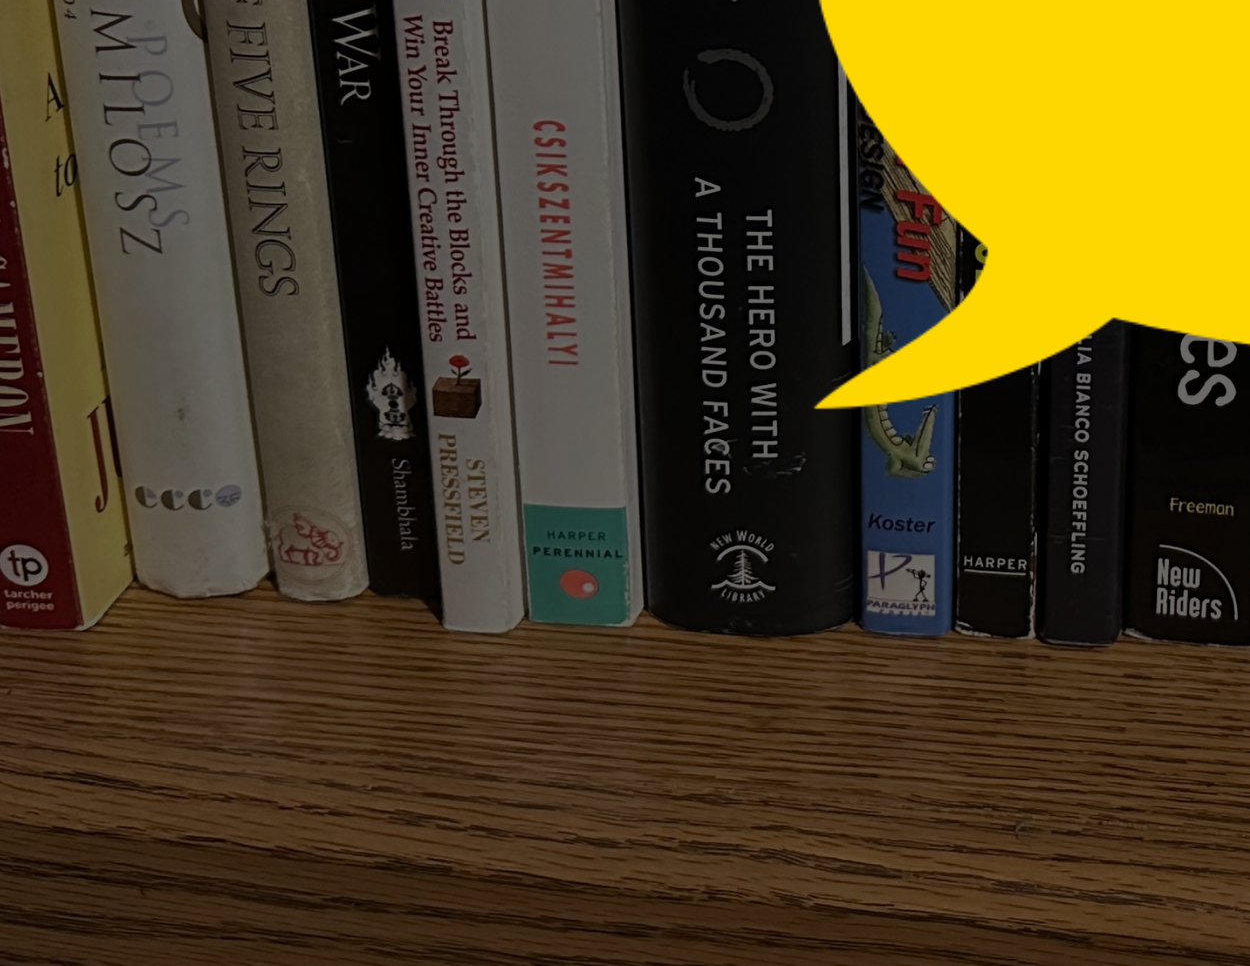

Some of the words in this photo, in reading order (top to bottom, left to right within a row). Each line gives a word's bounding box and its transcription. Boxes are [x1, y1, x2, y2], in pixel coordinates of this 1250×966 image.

[330, 2, 382, 107] WAR
[403, 14, 424, 62] Win
[432, 19, 453, 84] Break
[226, 21, 283, 132] FIVE
[405, 65, 428, 117] Your
[126, 32, 190, 231] POEMS
[410, 121, 432, 183] Inner
[436, 90, 466, 184] Through
[242, 146, 300, 299] RINGS
[416, 187, 438, 276] Creative
[444, 188, 465, 225] the
[895, 189, 943, 283] Fun
[447, 229, 470, 296] Blocks
[533, 119, 580, 367] CSIKSZENTMIHALYI
[744, 208, 775, 274] THE
[422, 277, 447, 343] Battles
[454, 301, 478, 341] and
[694, 210, 730, 389] THOUSAND
[746, 284, 778, 373] HERO
[749, 381, 781, 461] WITH
[1073, 372, 1093, 444] BIANCO
[702, 397, 733, 497] FACES
[389, 457, 420, 552] Shambhala
[437, 433, 466, 566] PRESSFIELD
[465, 458, 491, 544] STEVEN
[868, 513, 936, 533] Koster
[1069, 448, 1090, 576] SCHOEFFLING
[1169, 496, 1235, 517] Freeman
[8, 550, 42, 577] tp
[533, 545, 623, 559] PERENNIAL
[547, 529, 606, 542] HARPER
[708, 532, 733, 552] NEW
[734, 528, 777, 554] WORLD
[963, 554, 1028, 572] HARPER
[3, 589, 54, 601] tarcher
[719, 586, 768, 604] LIBRARY
[1155, 587, 1223, 620] Riders
[1156, 557, 1202, 589] New
[5, 600, 56, 614] perigee
